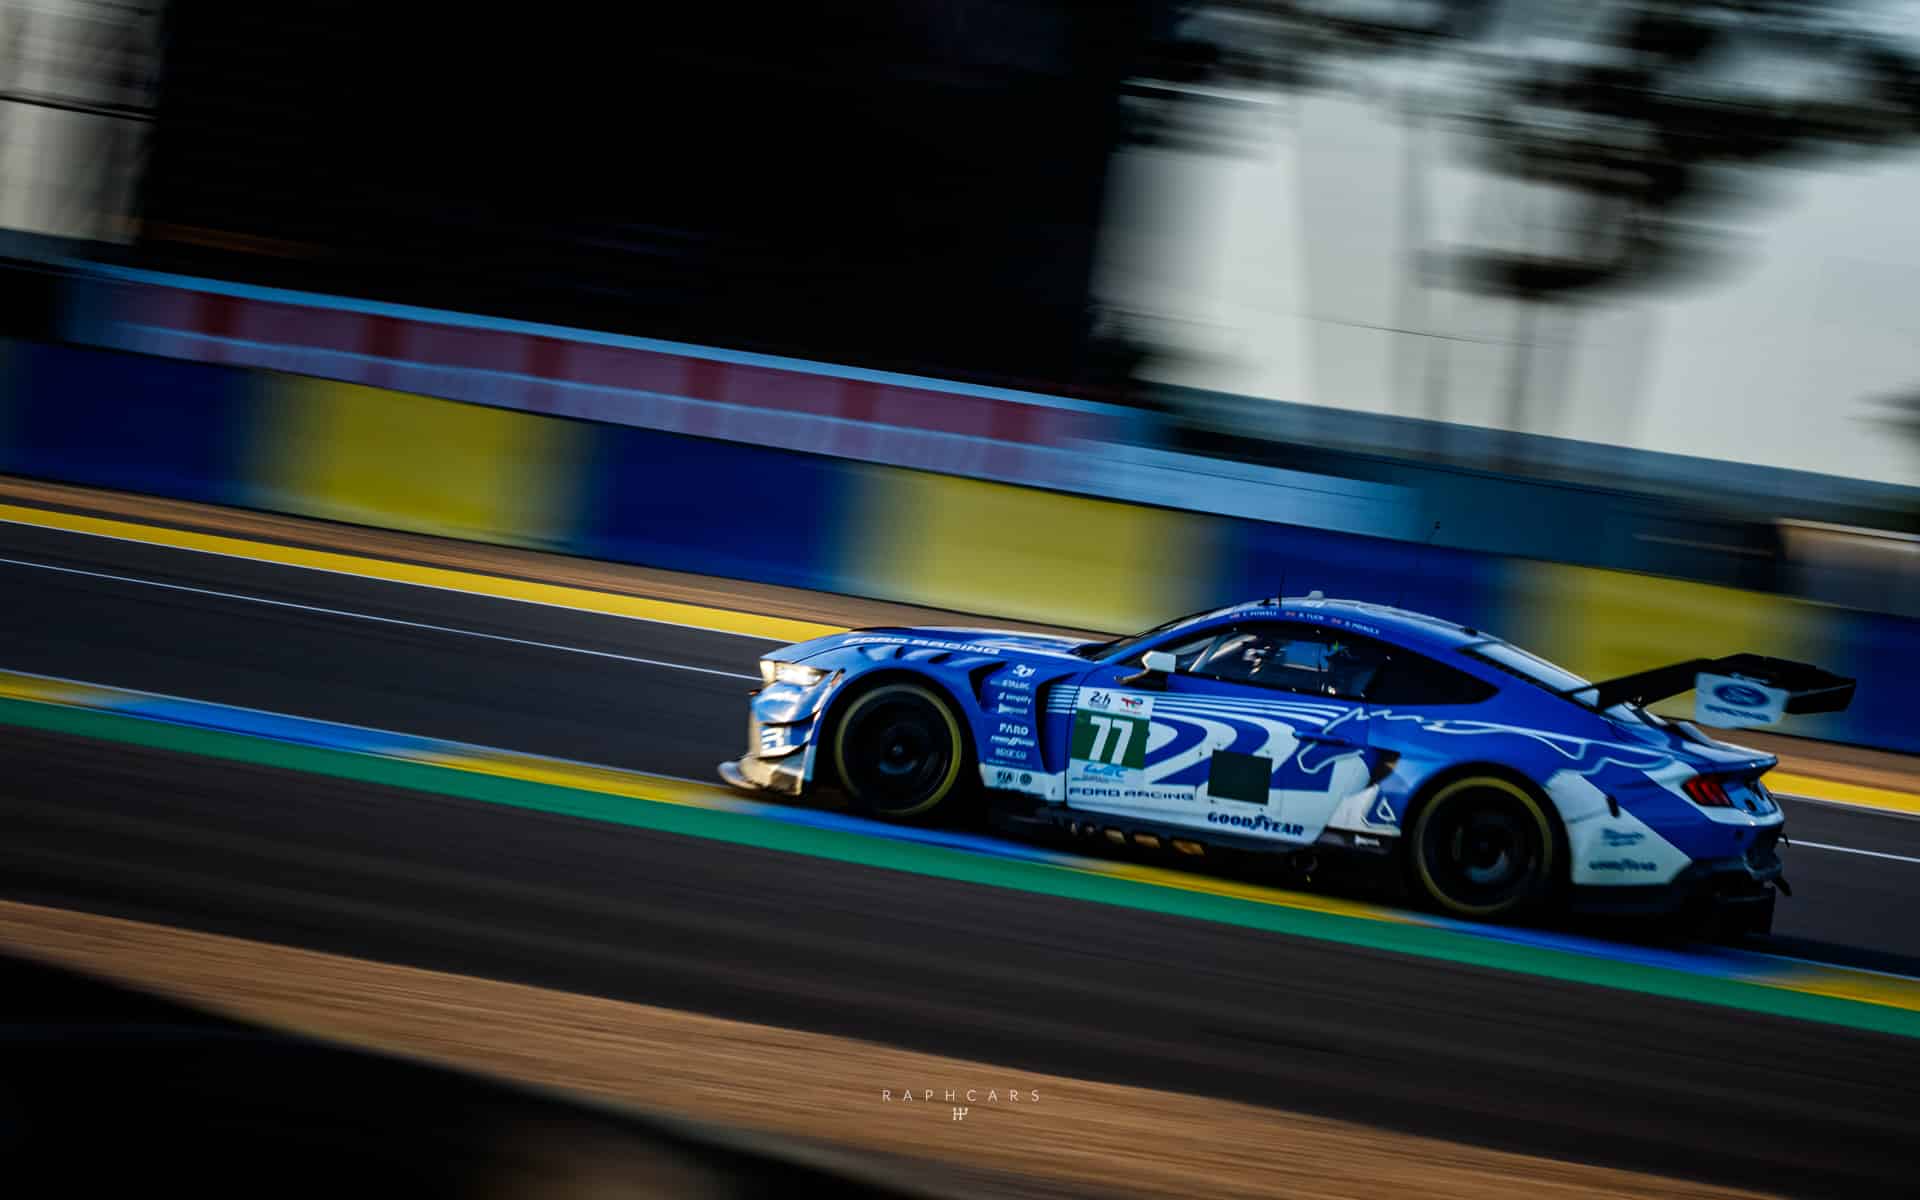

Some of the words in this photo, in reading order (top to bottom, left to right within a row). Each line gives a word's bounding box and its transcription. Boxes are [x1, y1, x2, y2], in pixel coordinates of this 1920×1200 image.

[842, 636, 909, 645] FORD
[911, 639, 1000, 655] RACING
[1088, 715, 1134, 765] 77
[1069, 786, 1121, 798] FORD
[1124, 789, 1195, 801] RACING
[1206, 811, 1305, 837] GOODYEAR
